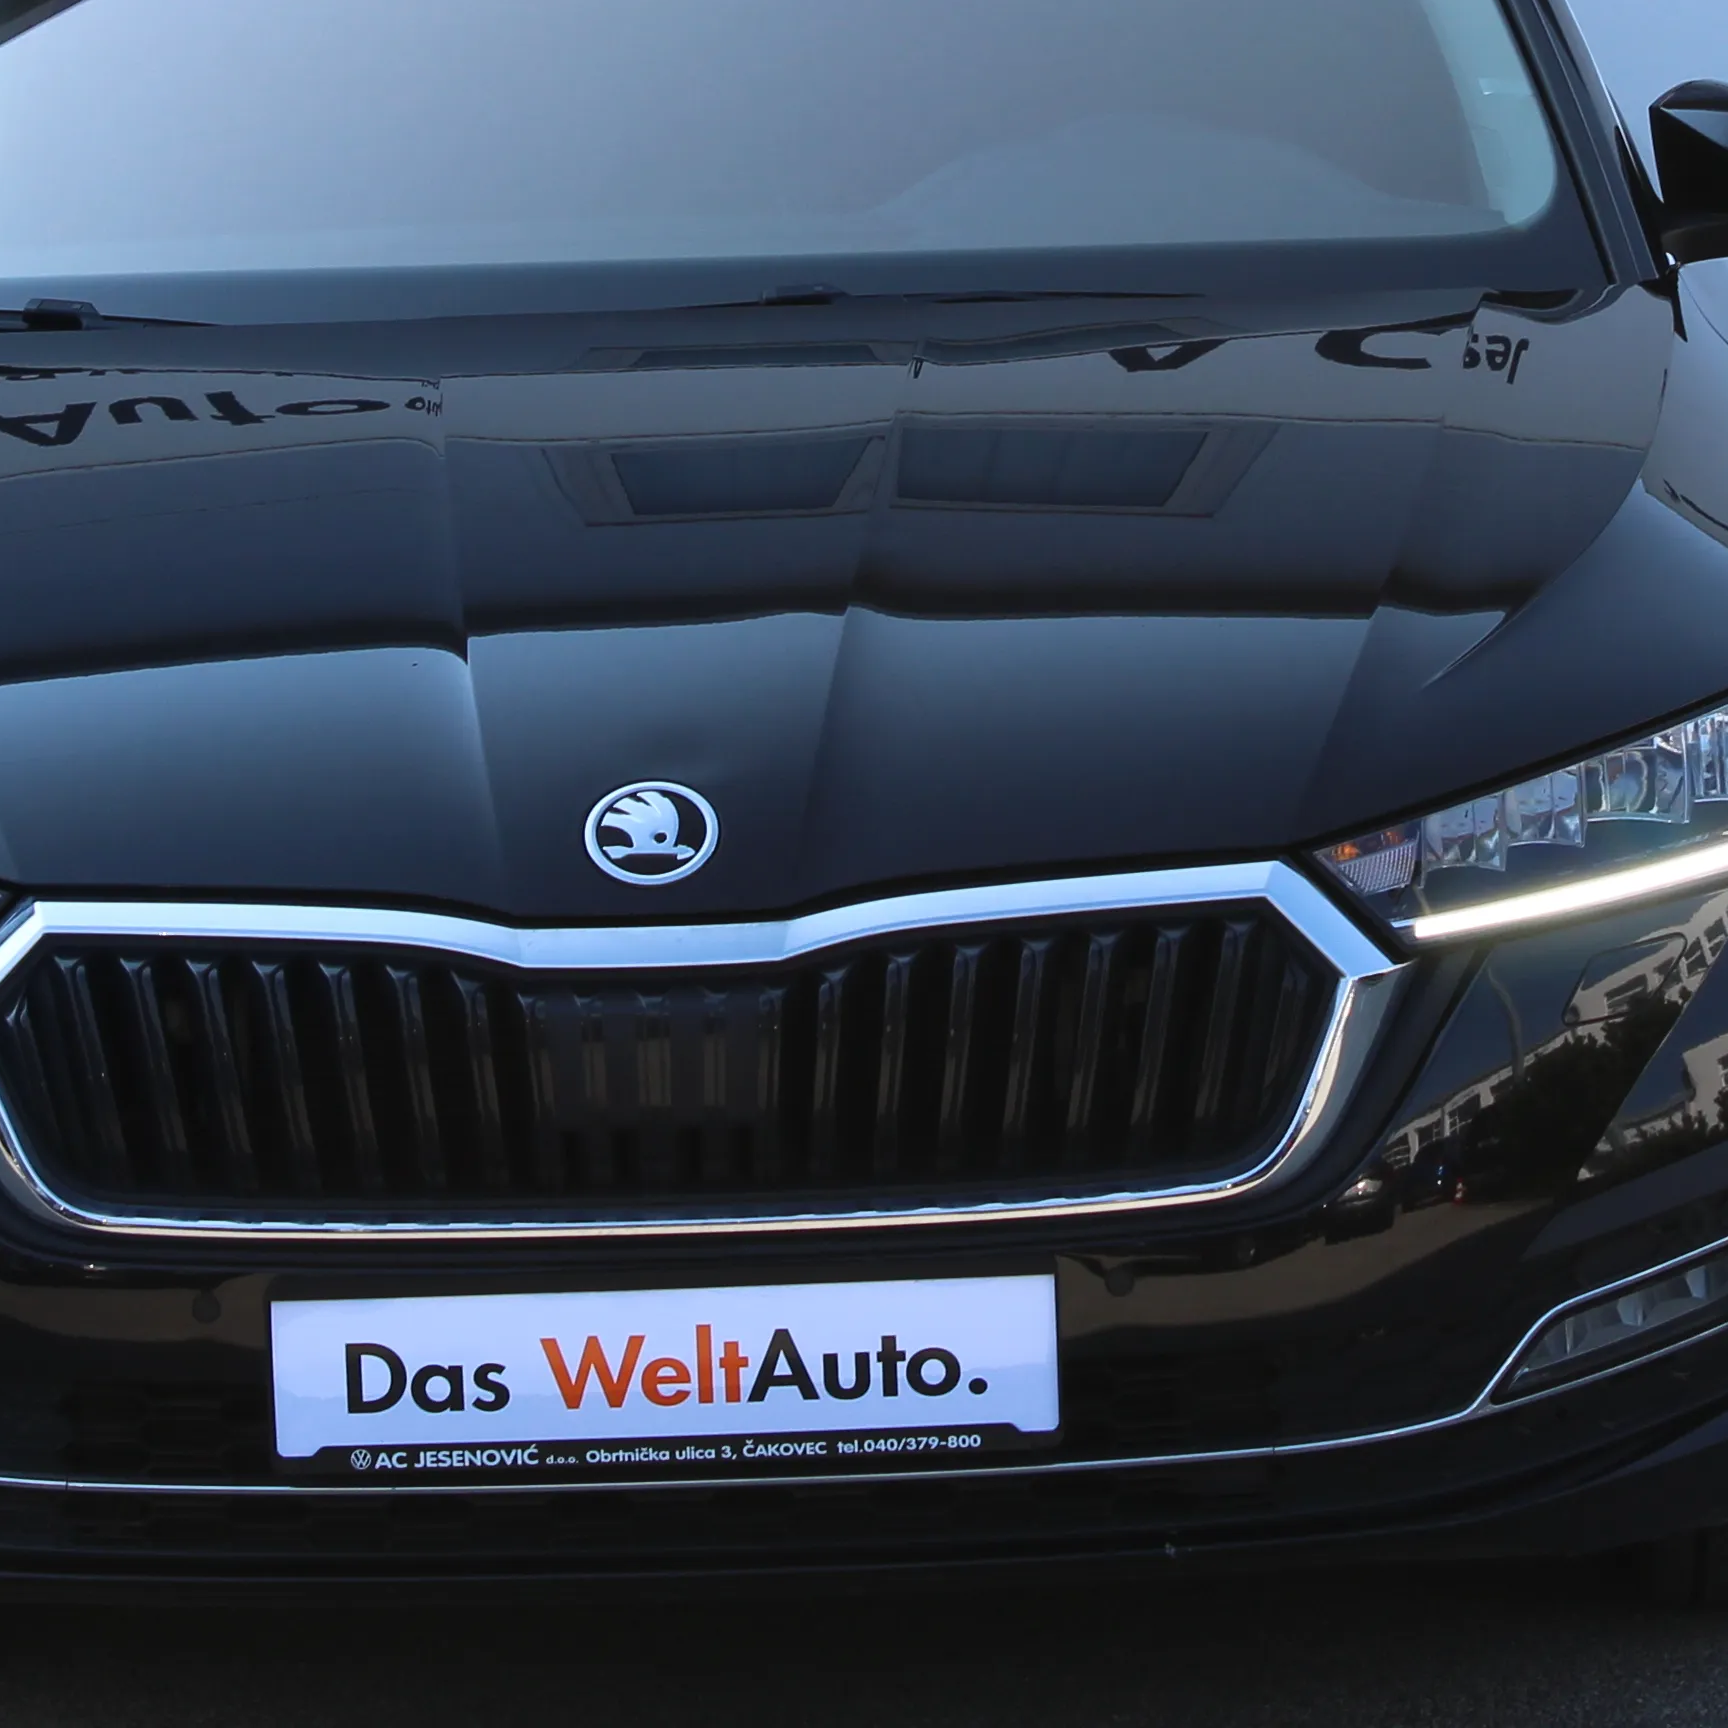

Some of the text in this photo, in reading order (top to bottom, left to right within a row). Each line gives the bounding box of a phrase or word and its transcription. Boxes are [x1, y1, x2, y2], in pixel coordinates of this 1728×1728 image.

[345, 1324, 989, 1415] Das WeltAuto.
[375, 1452, 408, 1470] AC
[414, 1444, 540, 1469] JESENOVIĆ
[546, 1454, 579, 1465] d.o.o.
[586, 1445, 671, 1464] Obrtnička
[676, 1445, 716, 1461] ulica
[721, 1445, 738, 1461] 3,
[743, 1439, 828, 1458] ČAKOVEC
